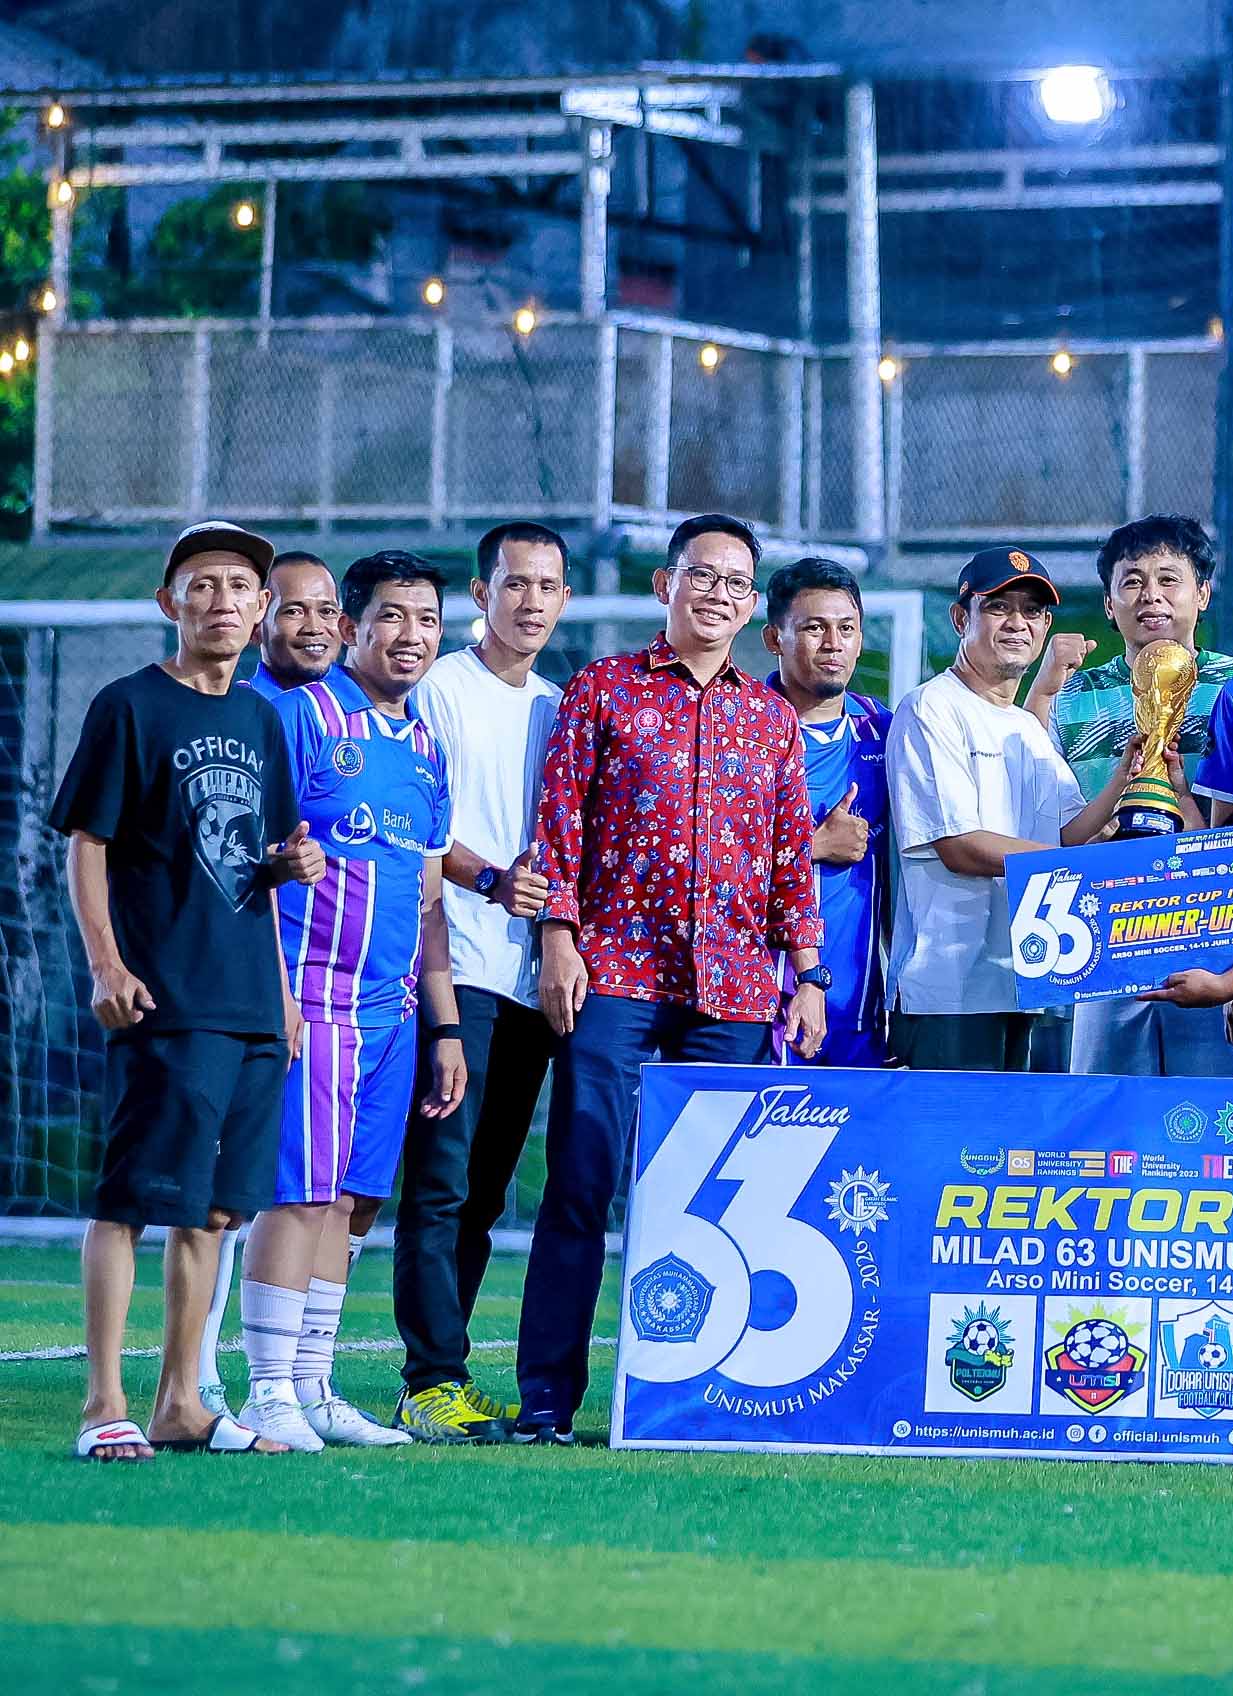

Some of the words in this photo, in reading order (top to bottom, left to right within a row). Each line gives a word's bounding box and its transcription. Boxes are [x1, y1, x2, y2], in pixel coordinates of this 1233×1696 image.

[384, 808, 412, 831] Bank
[1050, 867, 1083, 889] Tahun
[1109, 895, 1181, 913] REKTOR
[1186, 890, 1223, 903] CUP
[1010, 872, 1093, 978] 63
[1112, 951, 1133, 959] ARSO
[1134, 948, 1152, 956] MINI
[1154, 944, 1187, 954] SOCCER,
[1189, 941, 1209, 950] 14-15
[1211, 938, 1229, 947] JUNI
[1049, 975, 1083, 986] UNISMUH
[1083, 942, 1102, 978] MAKASSAR
[750, 1085, 851, 1136] Tahun
[966, 1154, 1000, 1162] UNGGUL
[1037, 1160, 1082, 1168] UNIVERSITY
[1112, 1155, 1134, 1174] THE
[1142, 1154, 1165, 1162] World
[1142, 1161, 1181, 1171] University
[1037, 1168, 1077, 1176] RANKINGS
[1141, 1169, 1177, 1179] Rankings
[1179, 1170, 1199, 1178] 2023
[625, 1090, 854, 1387] 63
[931, 1236, 1046, 1267] MILAD
[1056, 1239, 1097, 1267] 63
[986, 1271, 1044, 1290] Arso
[1050, 1271, 1102, 1291] Mini
[1108, 1272, 1198, 1296] Soccer,
[704, 1383, 804, 1416] UNISMUH
[808, 1308, 881, 1405] MAKASSAR
[851, 1240, 880, 1288] 2026
[1168, 1371, 1203, 1392] DOKAR
[1179, 1392, 1218, 1407] FOOTBALL
[915, 1425, 1055, 1440] https://unismuh.ac.id
[1112, 1431, 1220, 1444] official.unismuh
